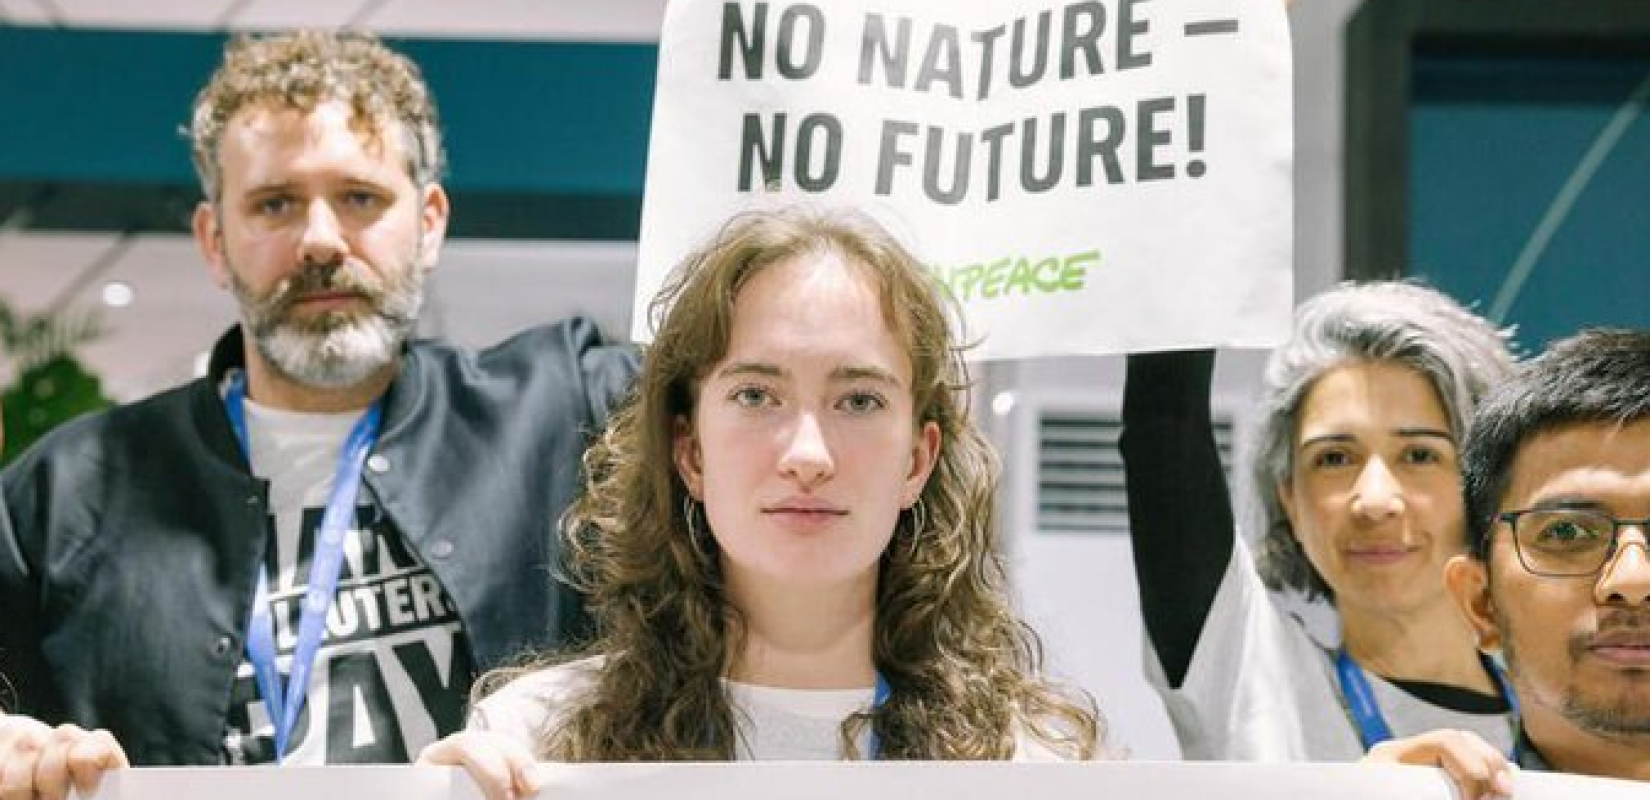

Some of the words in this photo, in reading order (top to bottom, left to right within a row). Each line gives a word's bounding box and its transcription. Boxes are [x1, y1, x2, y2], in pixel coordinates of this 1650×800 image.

[717, 2, 826, 80] NO
[857, 0, 1152, 101] NATURE
[738, 113, 843, 192] NO
[875, 94, 1207, 204] FUTURE!
